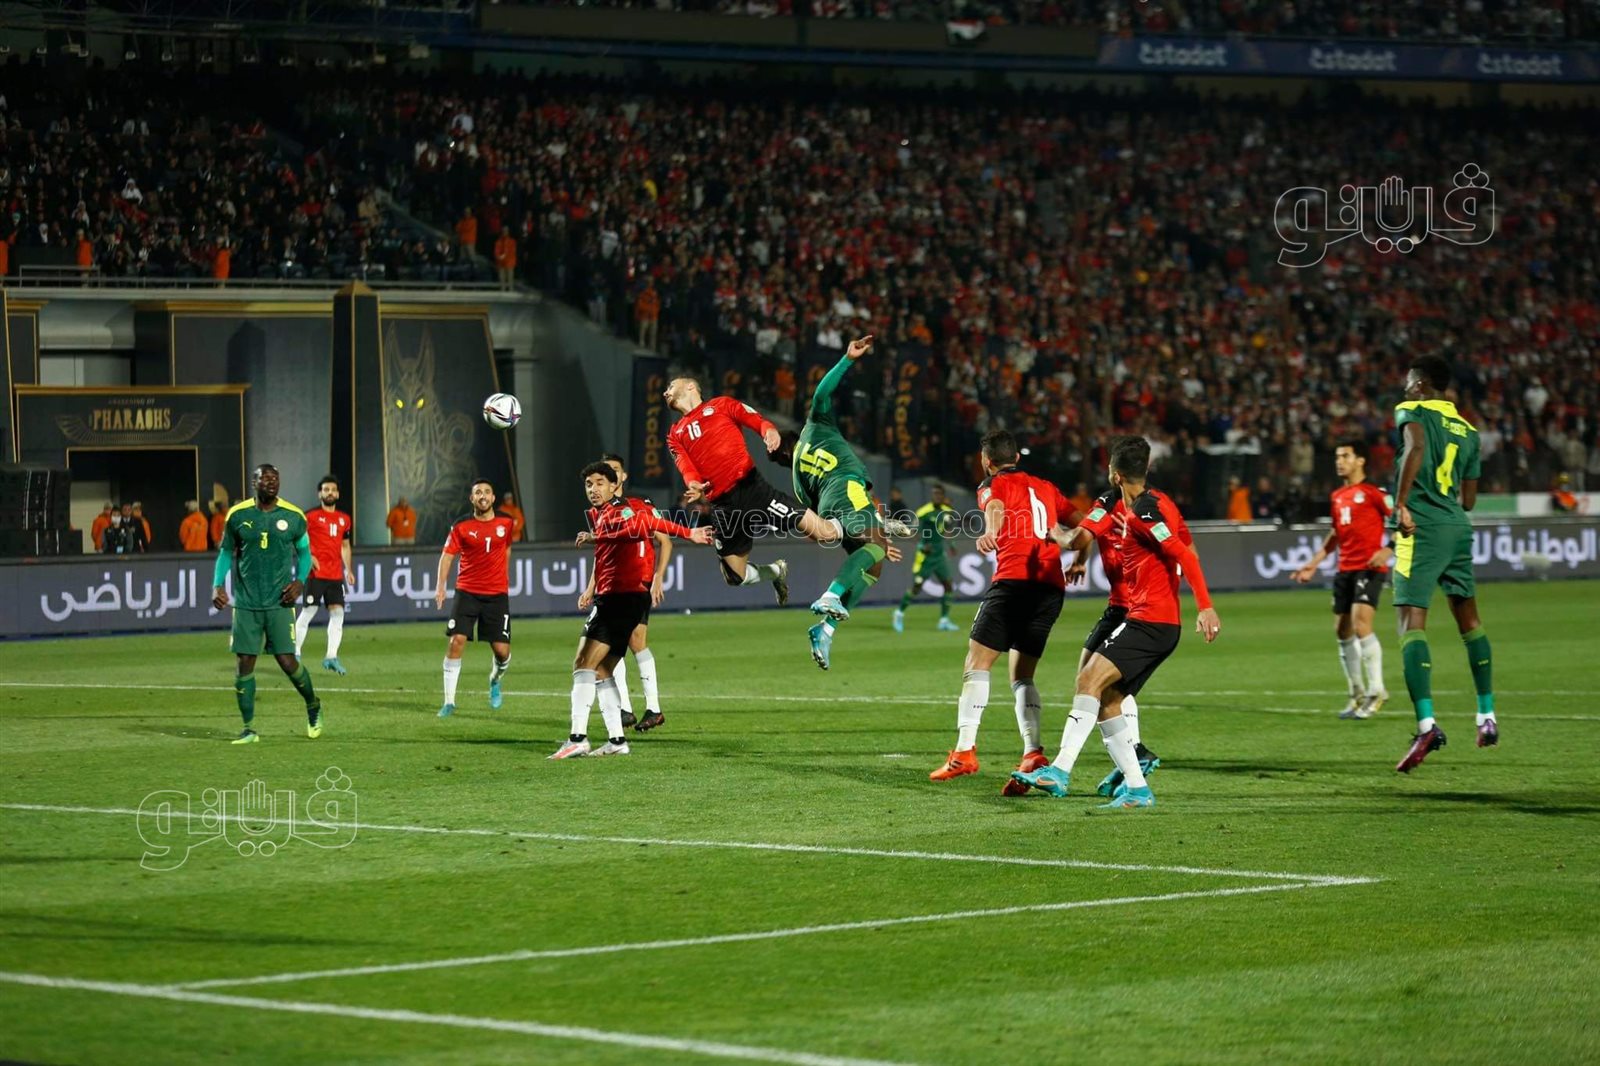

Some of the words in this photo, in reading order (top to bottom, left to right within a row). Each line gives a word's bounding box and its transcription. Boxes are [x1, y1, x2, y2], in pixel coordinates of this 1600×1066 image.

[93, 408, 171, 431] PHARAOHS
[799, 442, 838, 478] 15
[1436, 442, 1459, 496] 4
[260, 532, 268, 549] 3
